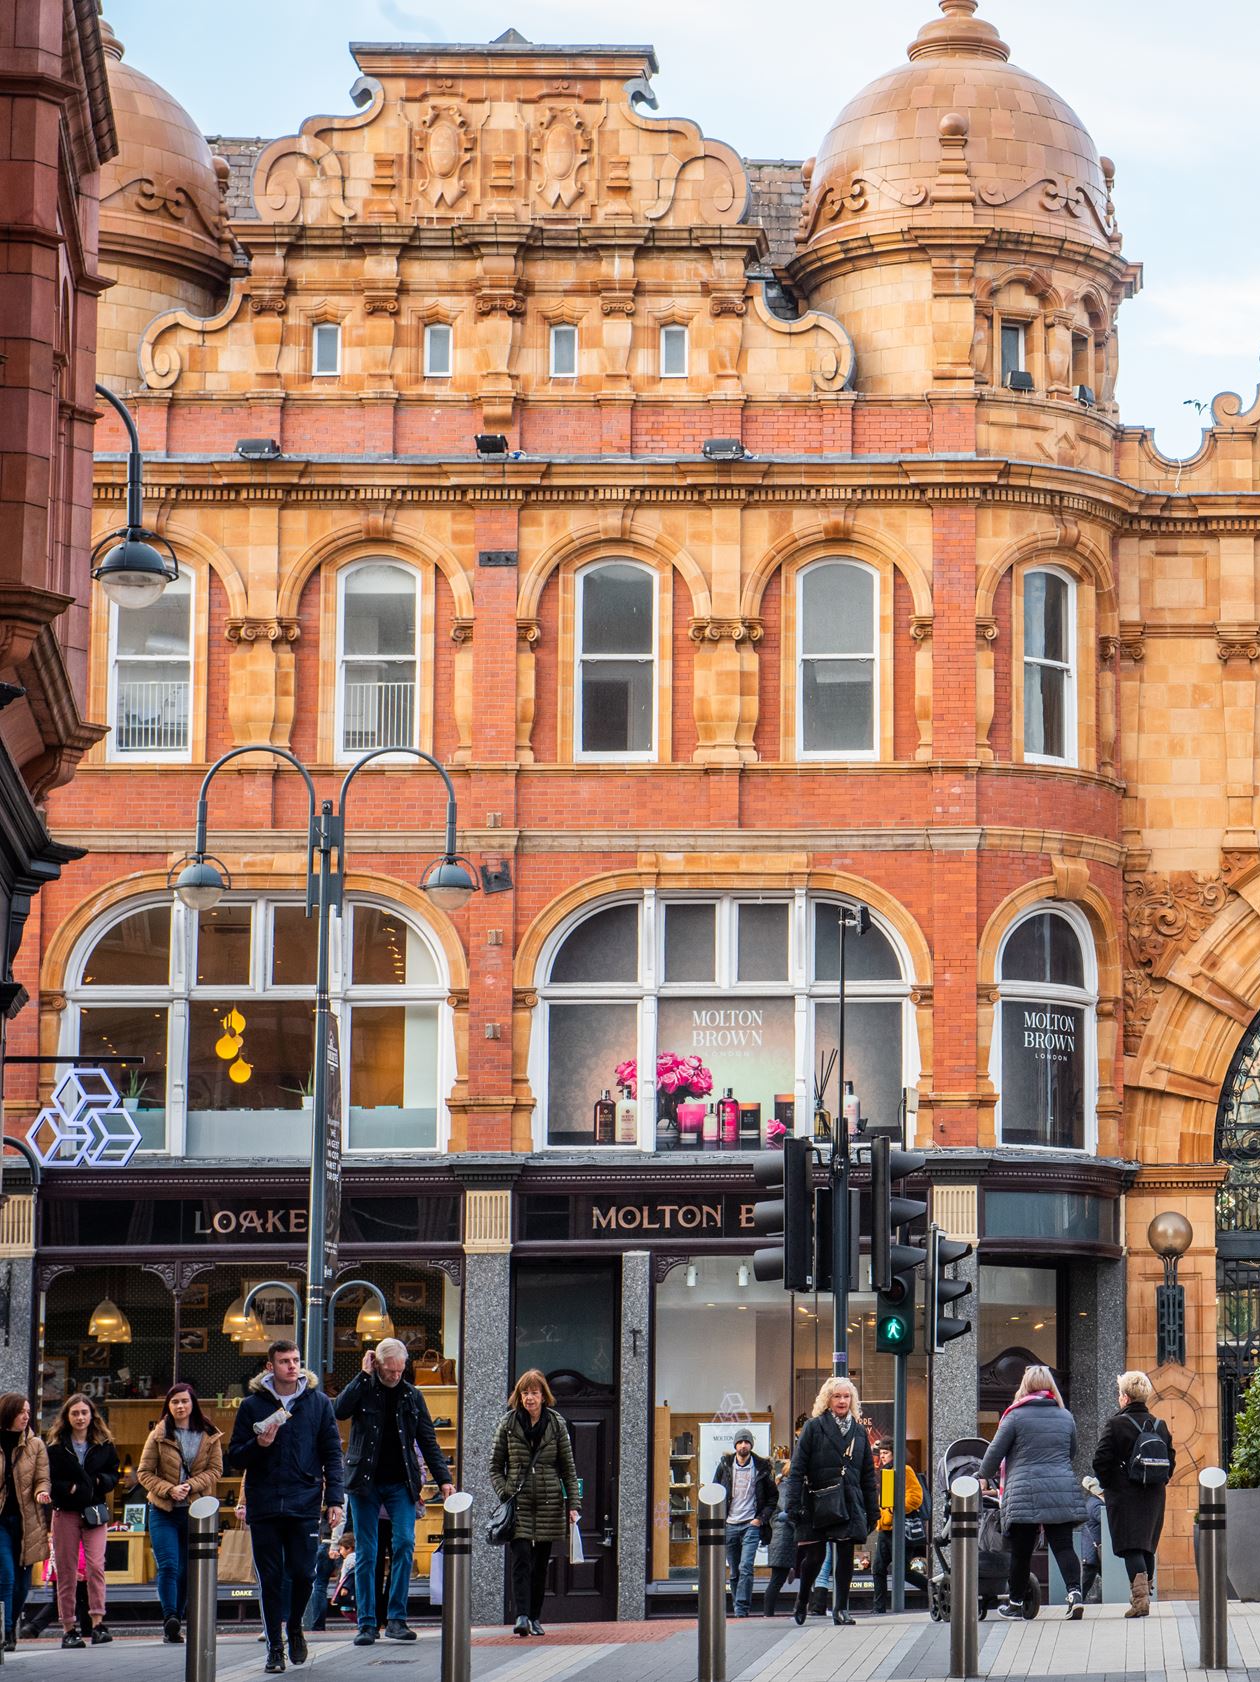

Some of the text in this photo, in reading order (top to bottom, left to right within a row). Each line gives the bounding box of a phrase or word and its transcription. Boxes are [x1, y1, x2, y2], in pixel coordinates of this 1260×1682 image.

[692, 1009, 763, 1027] MOLTON
[1023, 1011, 1075, 1032] MOLTON
[692, 1029, 763, 1047] BROWN
[1023, 1031, 1075, 1052] BROWN
[1035, 1053, 1068, 1061] LONDON
[194, 1209, 309, 1234] LOAKE
[592, 1205, 722, 1229] MOLTON
